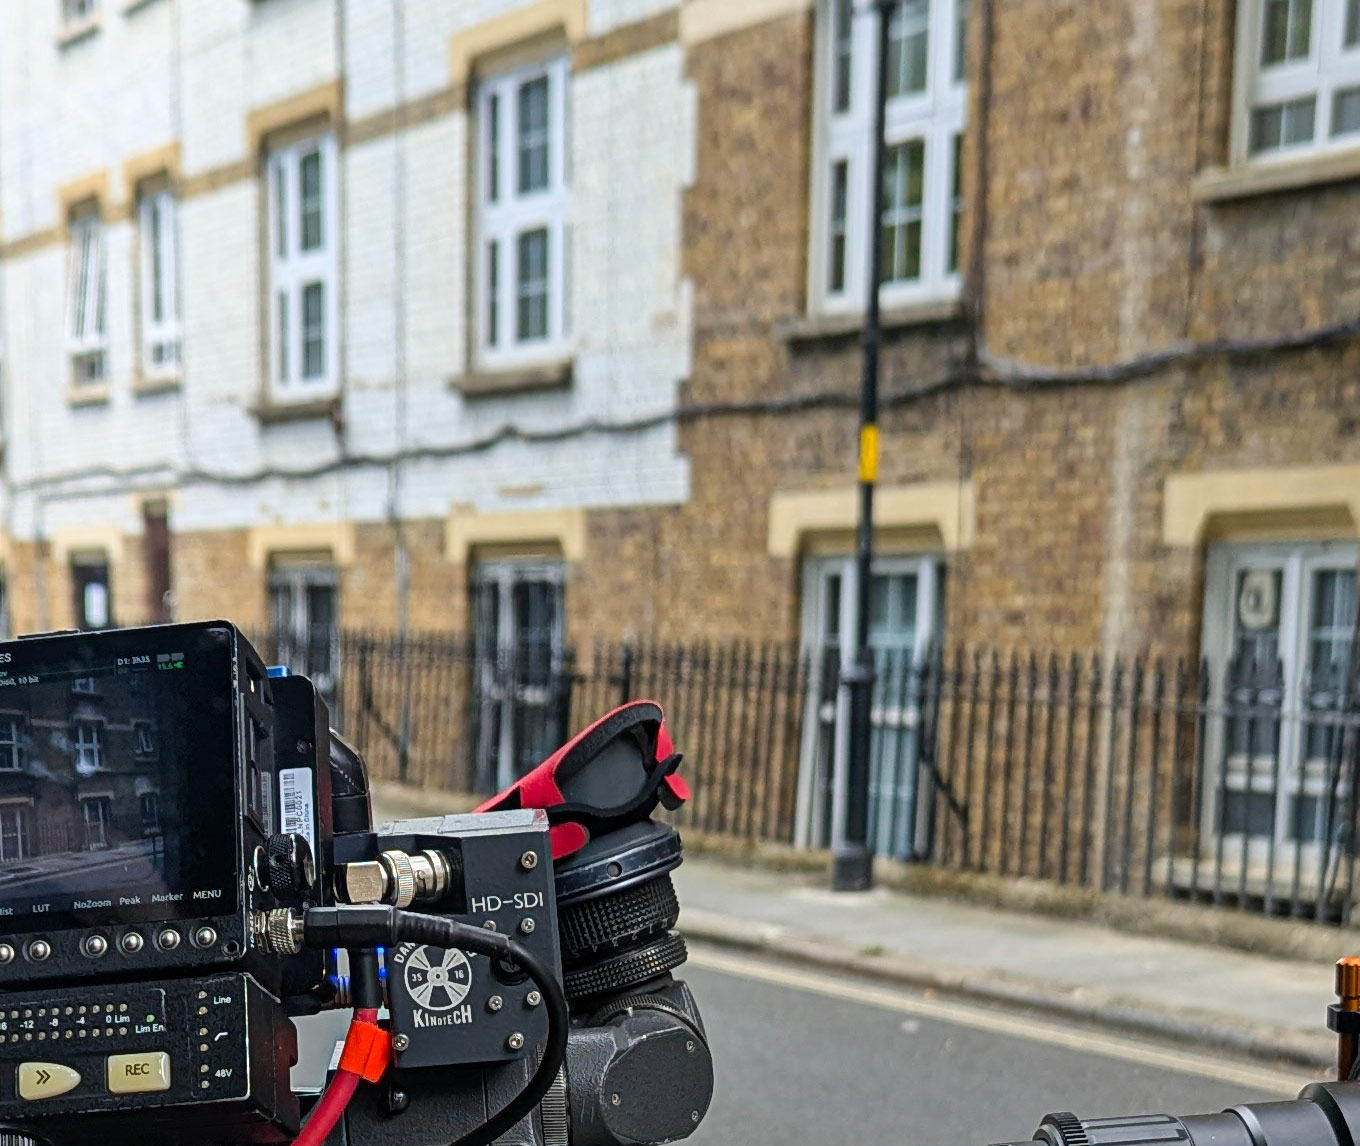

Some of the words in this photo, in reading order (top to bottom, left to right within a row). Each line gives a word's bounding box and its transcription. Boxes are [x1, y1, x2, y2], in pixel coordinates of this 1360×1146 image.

[152, 892, 184, 902] Marker
[193, 890, 222, 900] MENU
[74, 899, 112, 910] NoZoom
[120, 896, 141, 906] Peak
[471, 892, 544, 912] HD-SDI
[32, 904, 50, 914] LUT
[214, 996, 232, 1004] Line
[20, 1020, 34, 1028] -12
[49, 1018, 58, 1026] -8
[76, 1016, 85, 1024] -4
[106, 1015, 112, 1024] 0
[114, 1014, 130, 1024] Lim
[135, 1025, 150, 1034] Lim
[152, 1024, 164, 1032] En
[125, 1064, 150, 1076] REC
[214, 1069, 232, 1078] 48V
